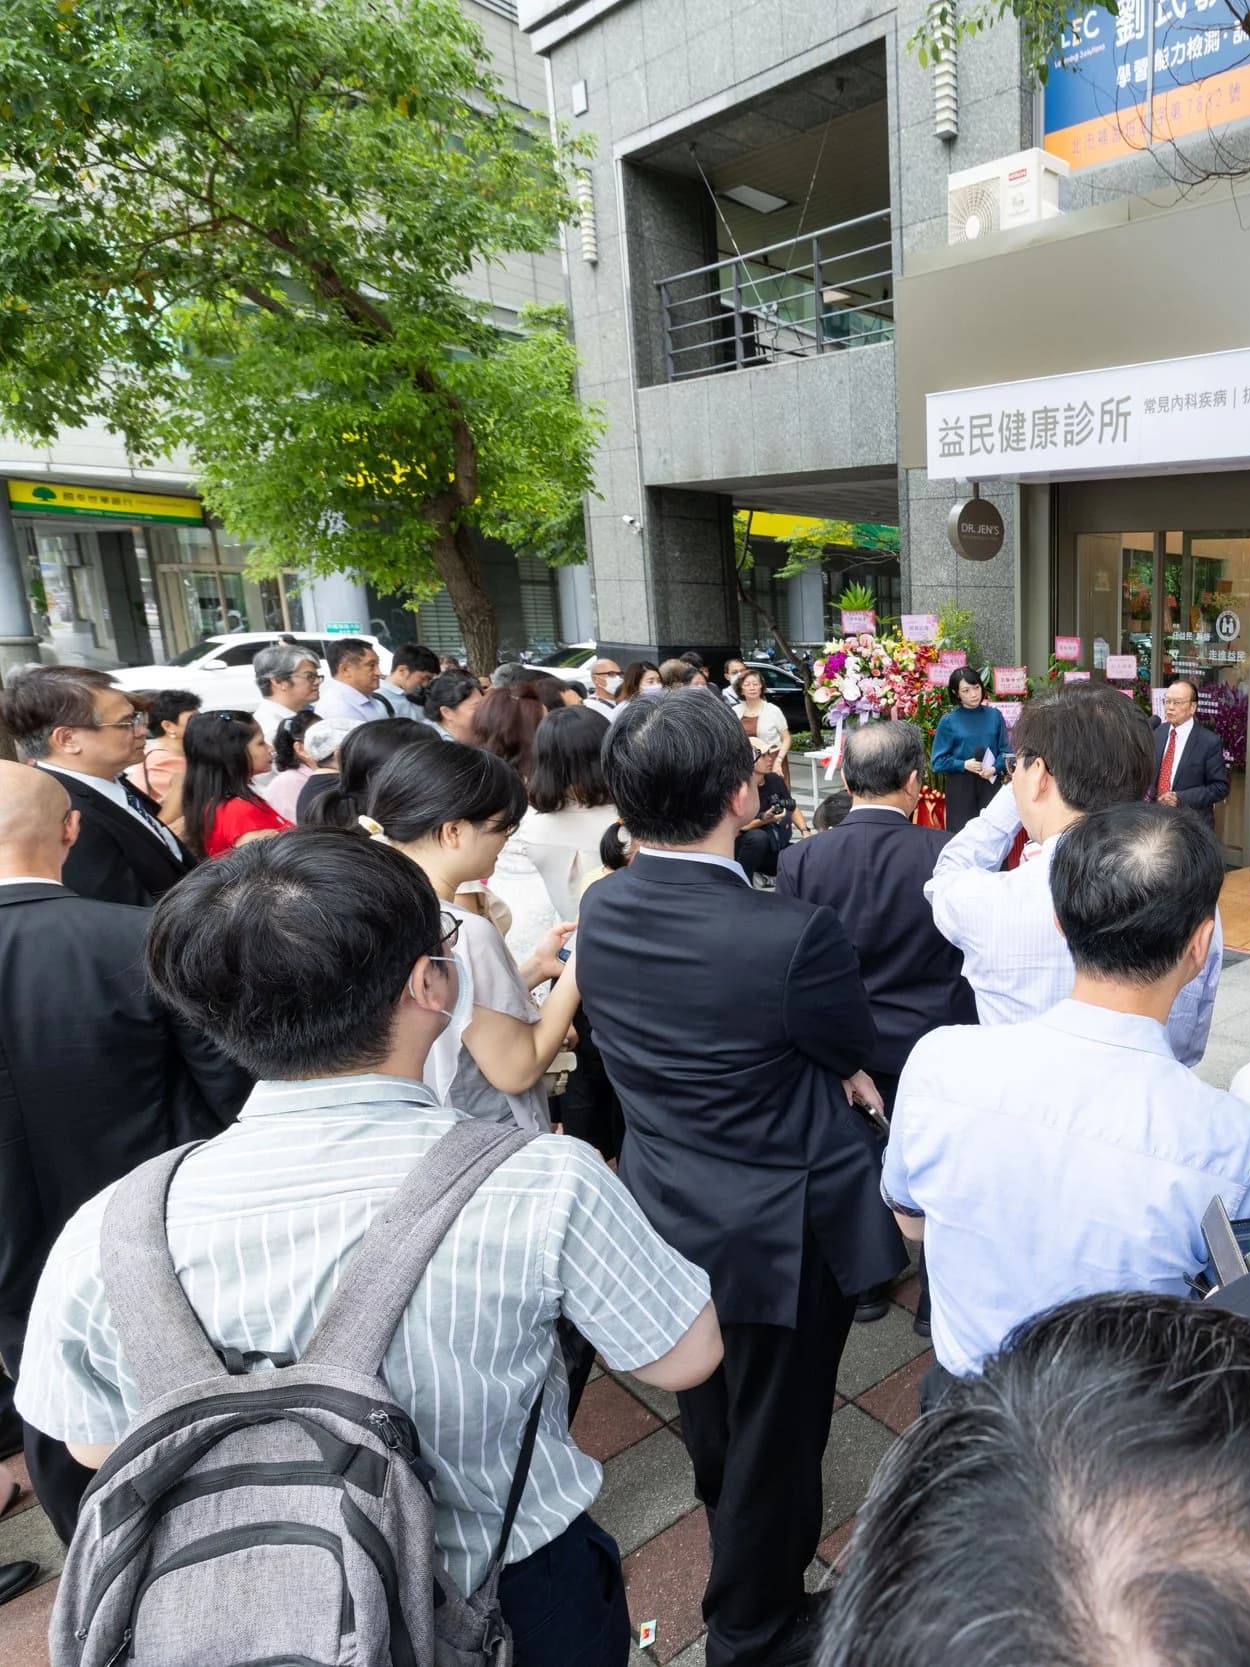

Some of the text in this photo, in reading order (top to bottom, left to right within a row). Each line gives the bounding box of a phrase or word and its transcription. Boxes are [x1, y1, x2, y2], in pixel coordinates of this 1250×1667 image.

[1143, 386, 1227, 415] 常見內科疾病
[938, 395, 1132, 458] 益民健康診所
[961, 523, 1000, 535] DR. JEN'S
